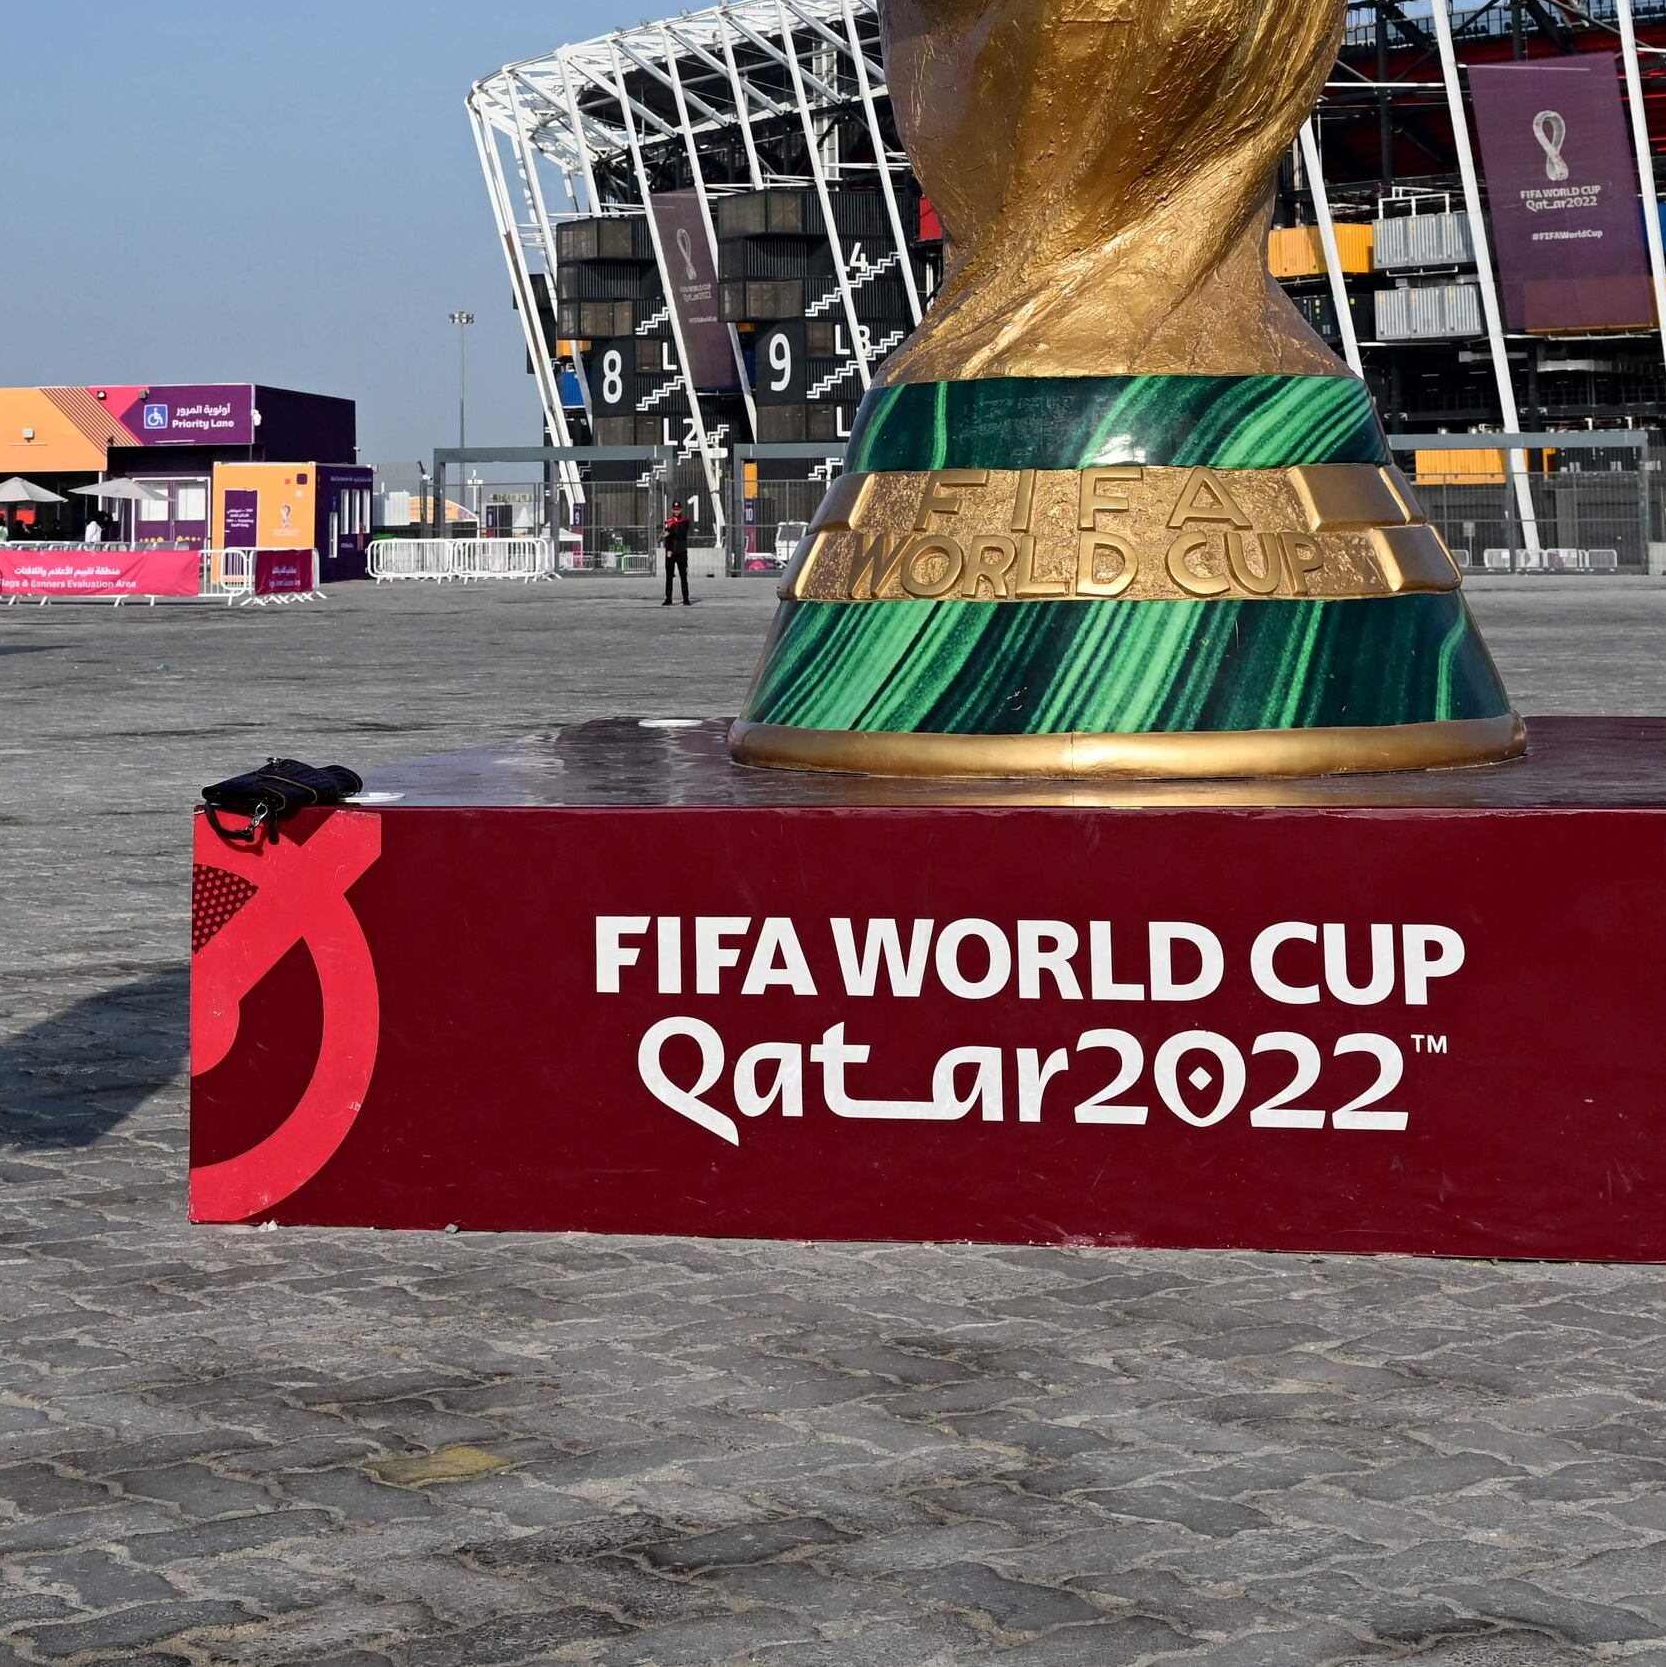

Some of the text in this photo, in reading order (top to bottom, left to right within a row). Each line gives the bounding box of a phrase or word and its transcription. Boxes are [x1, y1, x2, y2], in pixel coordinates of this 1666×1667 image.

[1520, 185, 1601, 200] FIFA WORLD CUP
[1525, 196, 1598, 212] Qatar2022
[602, 350, 623, 404] 8
[769, 333, 792, 392] 9
[172, 419, 234, 430] Priority Lane
[176, 404, 203, 417] المرور
[913, 467, 1253, 533] FIFA
[847, 530, 1324, 599] WORLD CUP
[31, 579, 65, 588] Banners
[67, 579, 114, 589] Evaluation
[115, 579, 137, 588] Area
[595, 915, 1466, 1007] FIFA WORLD CUP
